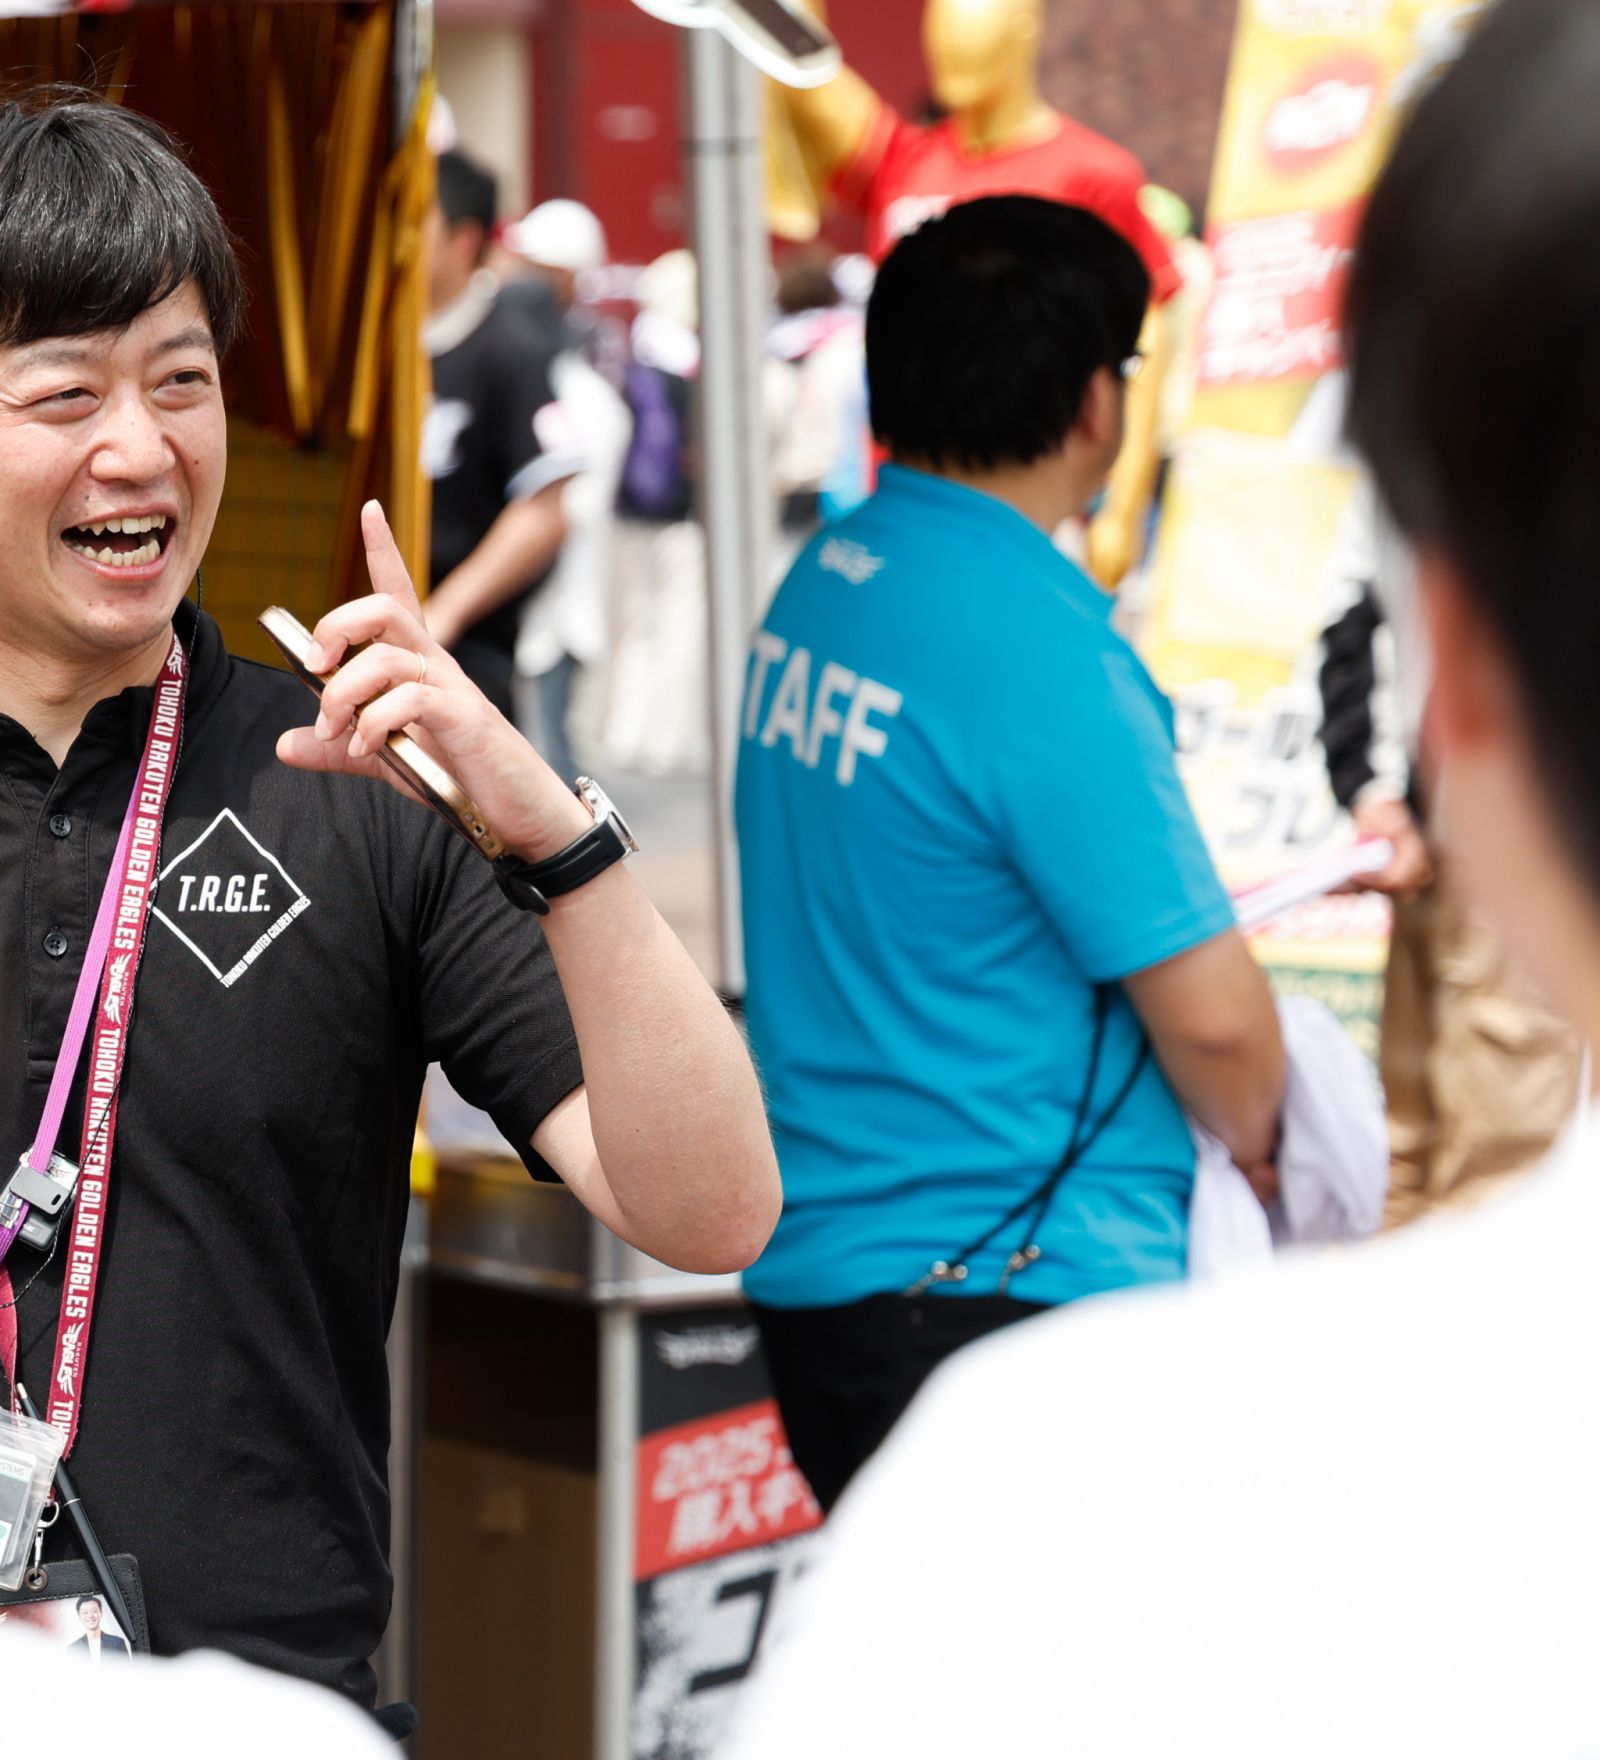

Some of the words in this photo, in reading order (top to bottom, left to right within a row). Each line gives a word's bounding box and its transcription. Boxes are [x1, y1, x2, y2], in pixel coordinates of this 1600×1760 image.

[153, 679, 182, 738] TOHOKU
[139, 739, 172, 815] RAKUTEN
[126, 817, 157, 882] GOLDEN
[114, 884, 145, 950] EAGLES
[178, 873, 271, 913] T.R.G.E.
[93, 1028, 121, 1093] TOHOKU
[83, 1097, 112, 1176] RAKUTEN
[75, 1180, 103, 1247] GOLDEN
[65, 1250, 94, 1319] EAGLES
[57, 1328, 80, 1390] EAGLES
[50, 1400, 74, 1438] TOH
[652, 1417, 792, 1501] 2025
